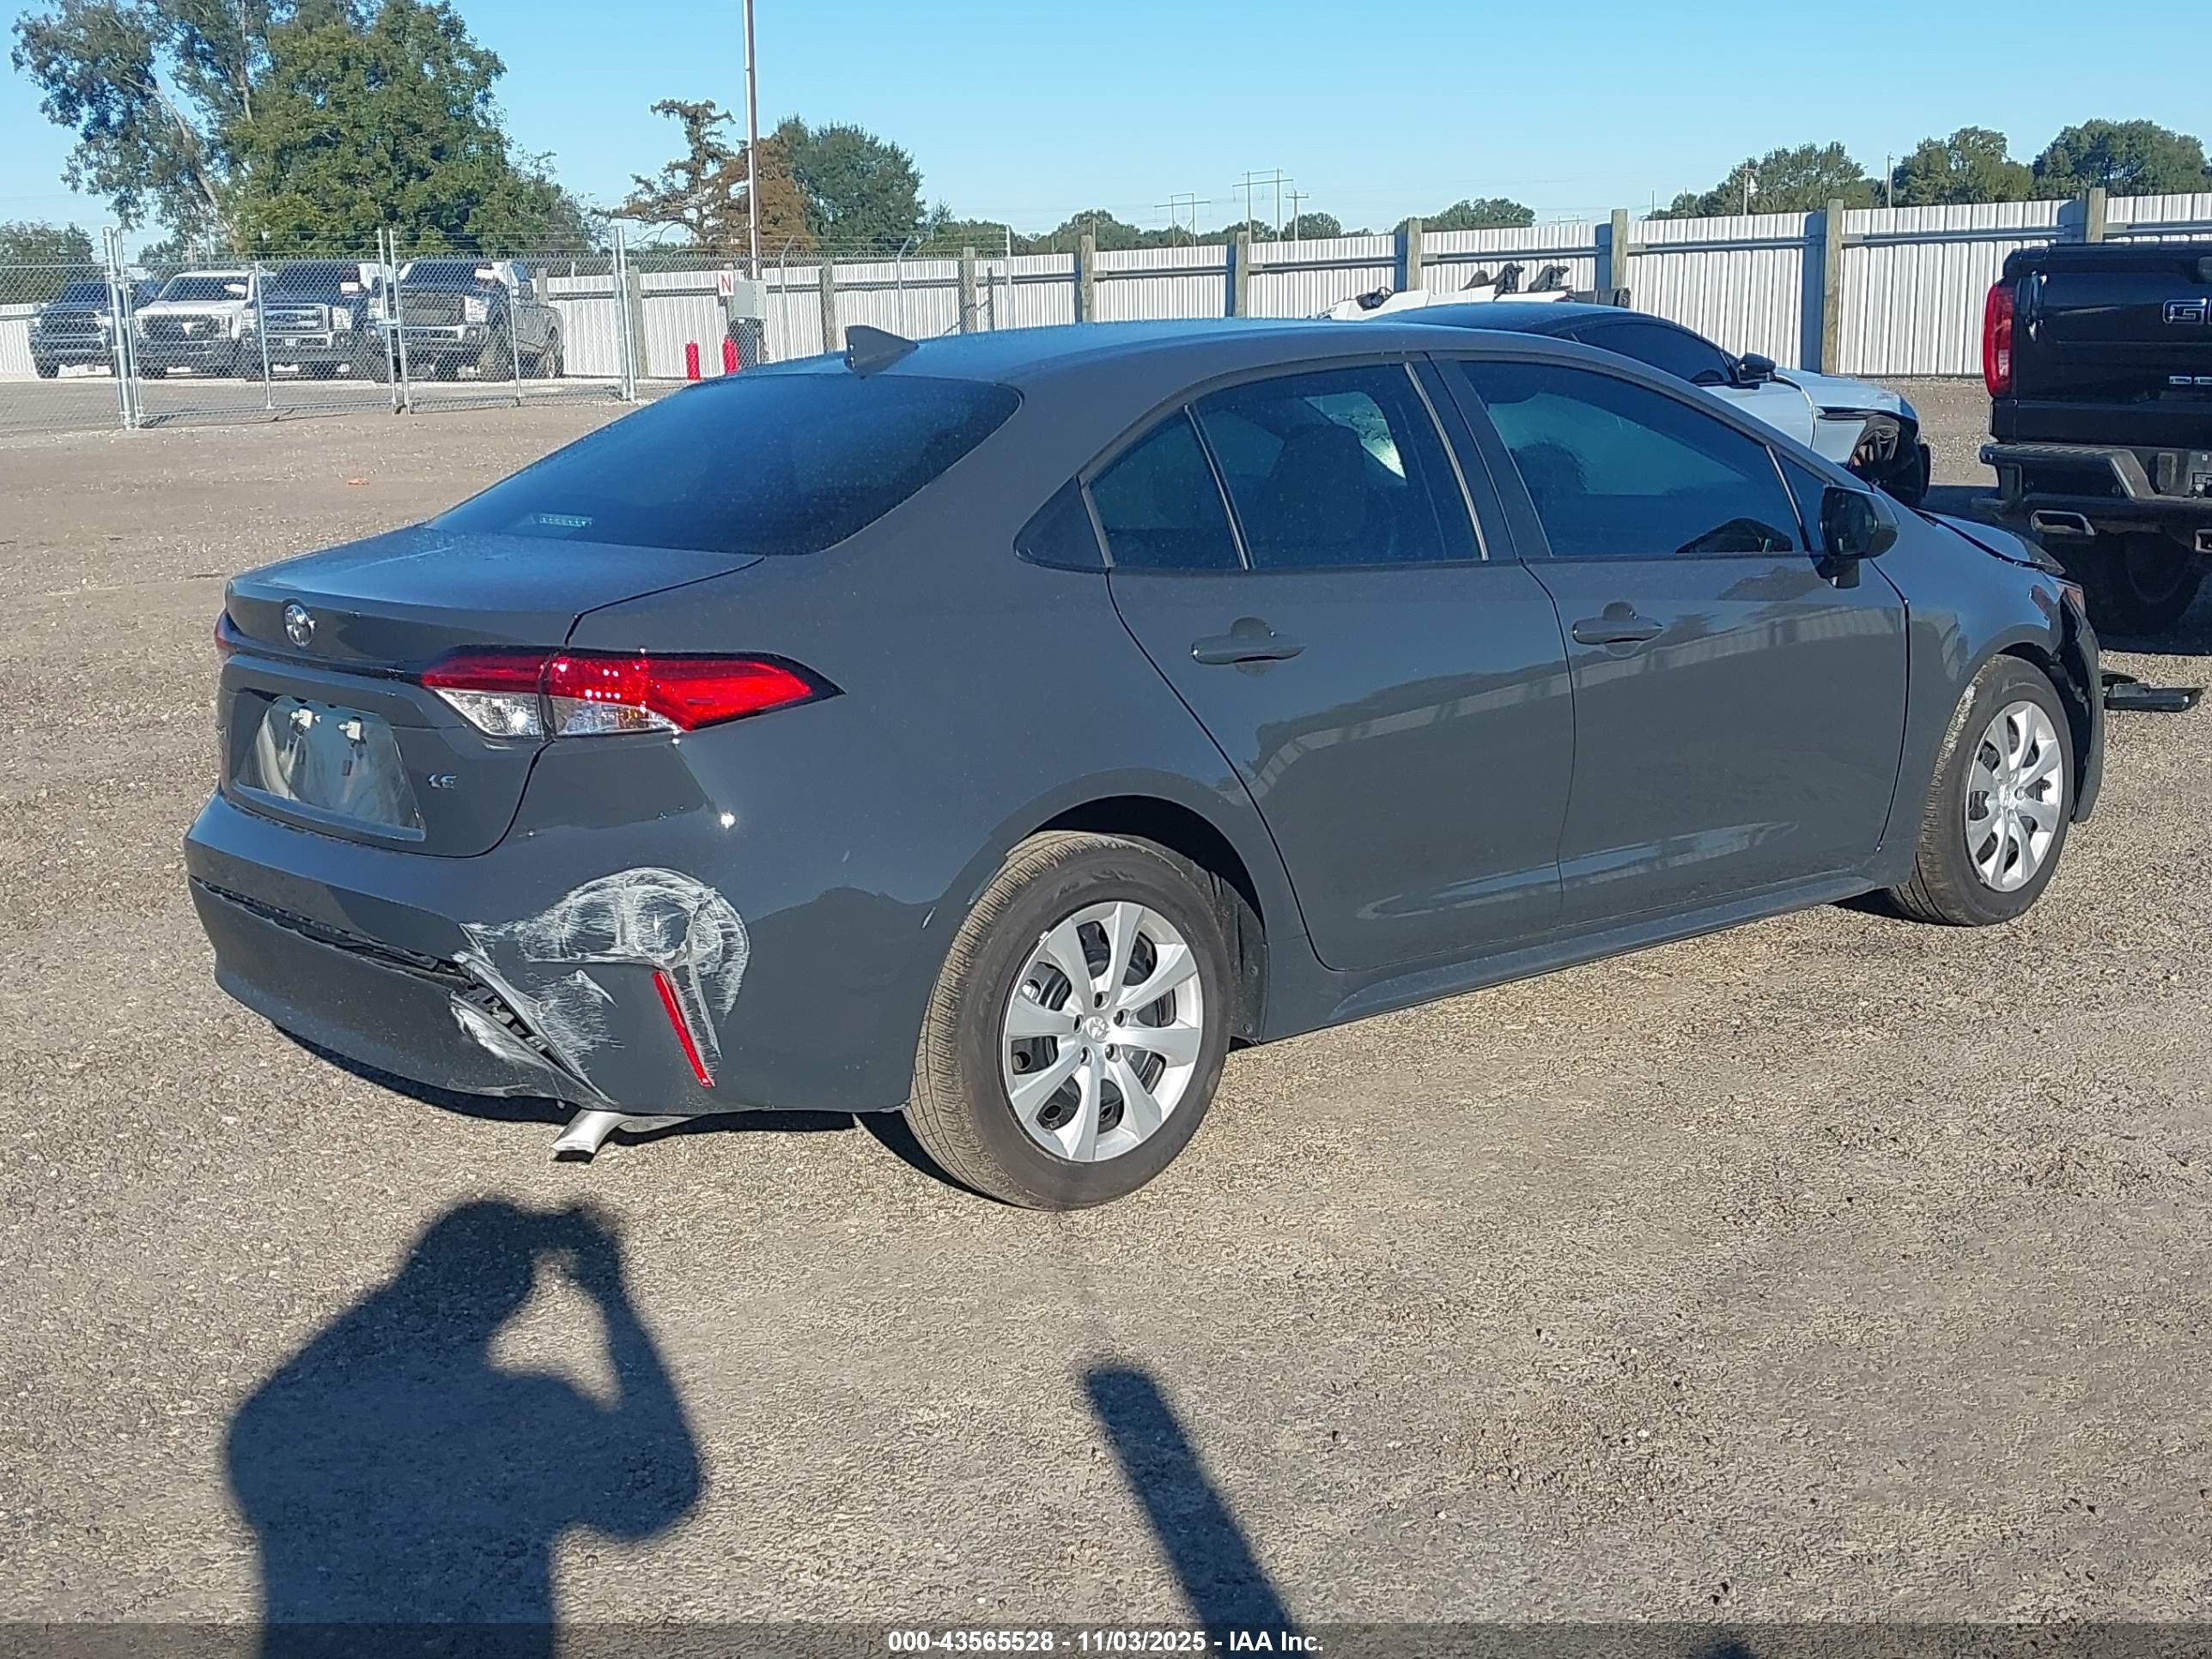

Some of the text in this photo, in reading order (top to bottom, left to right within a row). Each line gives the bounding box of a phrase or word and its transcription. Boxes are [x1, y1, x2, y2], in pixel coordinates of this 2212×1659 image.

[721, 274, 732, 293] N
[2162, 298, 2212, 325] G
[428, 775, 458, 789] LE
